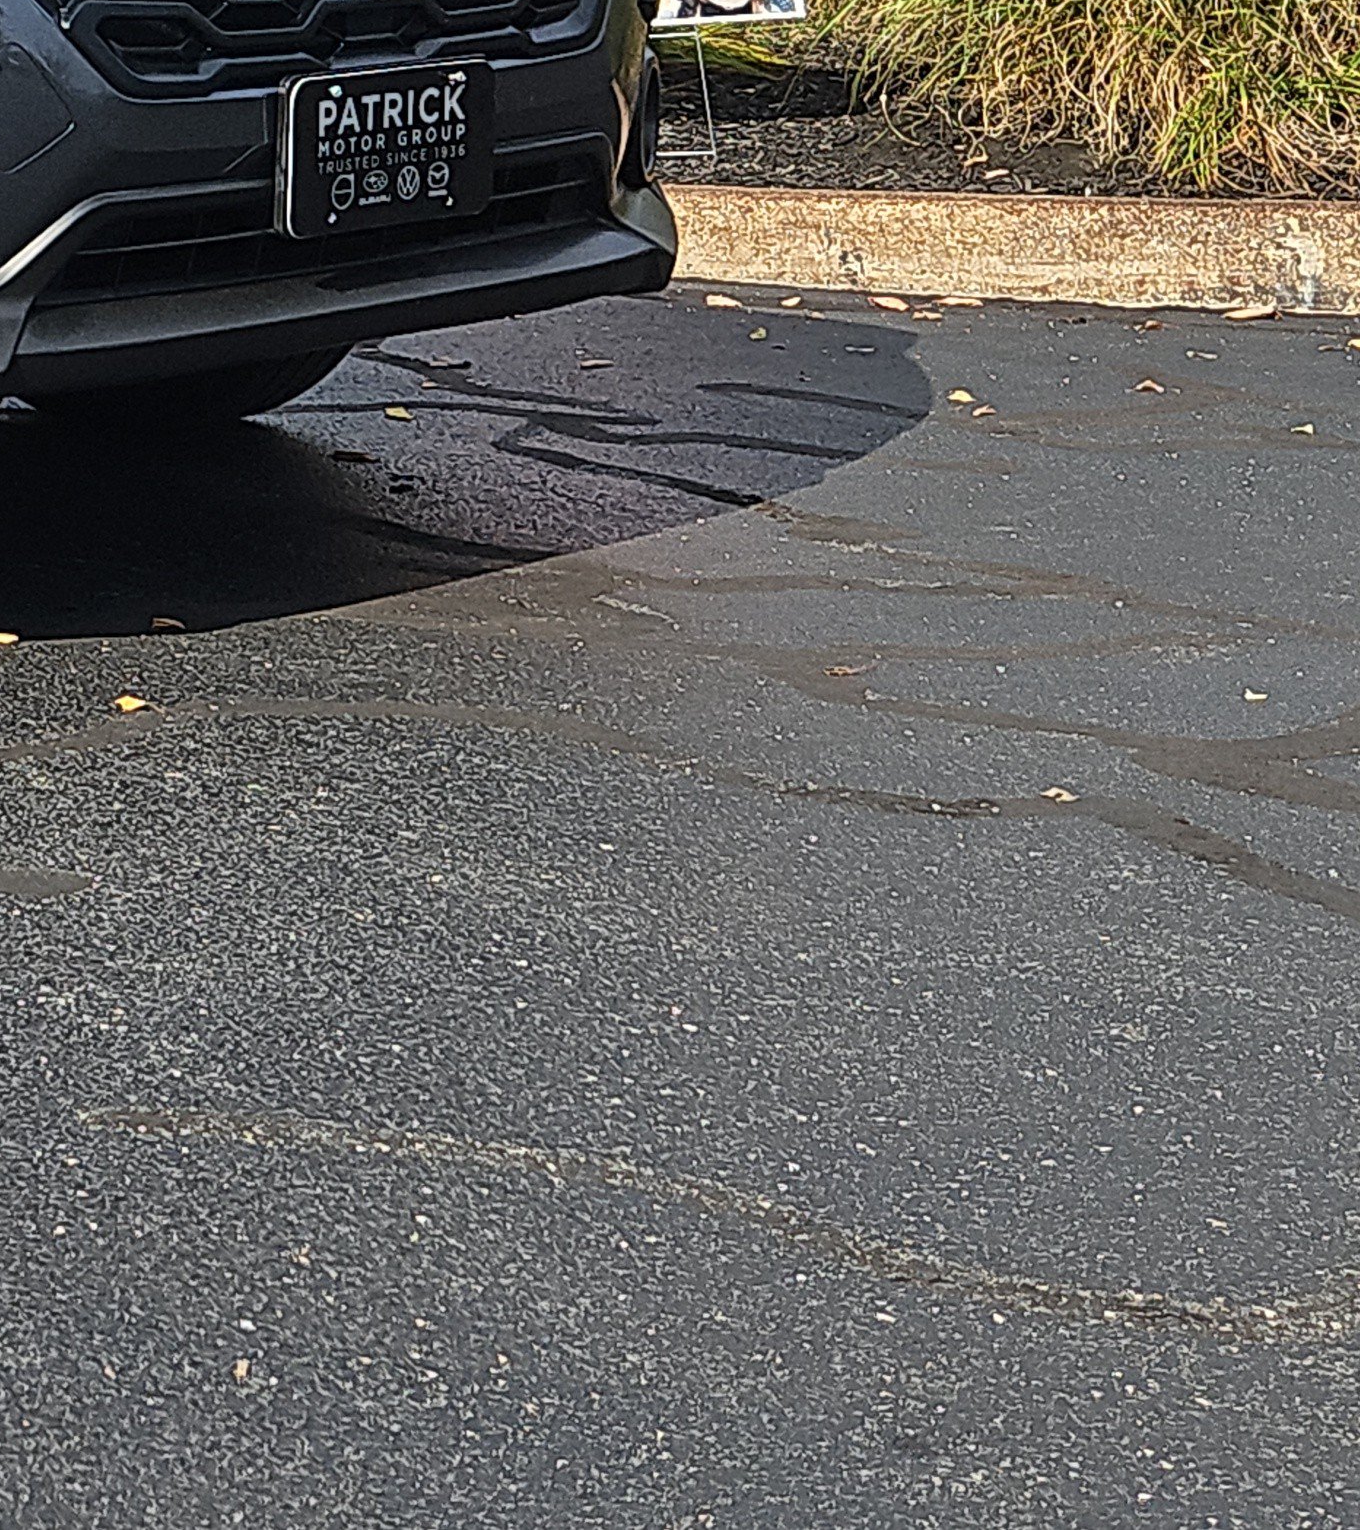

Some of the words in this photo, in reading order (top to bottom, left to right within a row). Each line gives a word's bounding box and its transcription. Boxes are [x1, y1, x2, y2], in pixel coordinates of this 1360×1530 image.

[318, 84, 466, 137] PATRICK
[318, 133, 385, 158] MOTOR
[397, 124, 466, 146] GROUP
[318, 156, 380, 175] TRUSTED
[386, 148, 427, 166] SINCE
[434, 144, 466, 159] 1936
